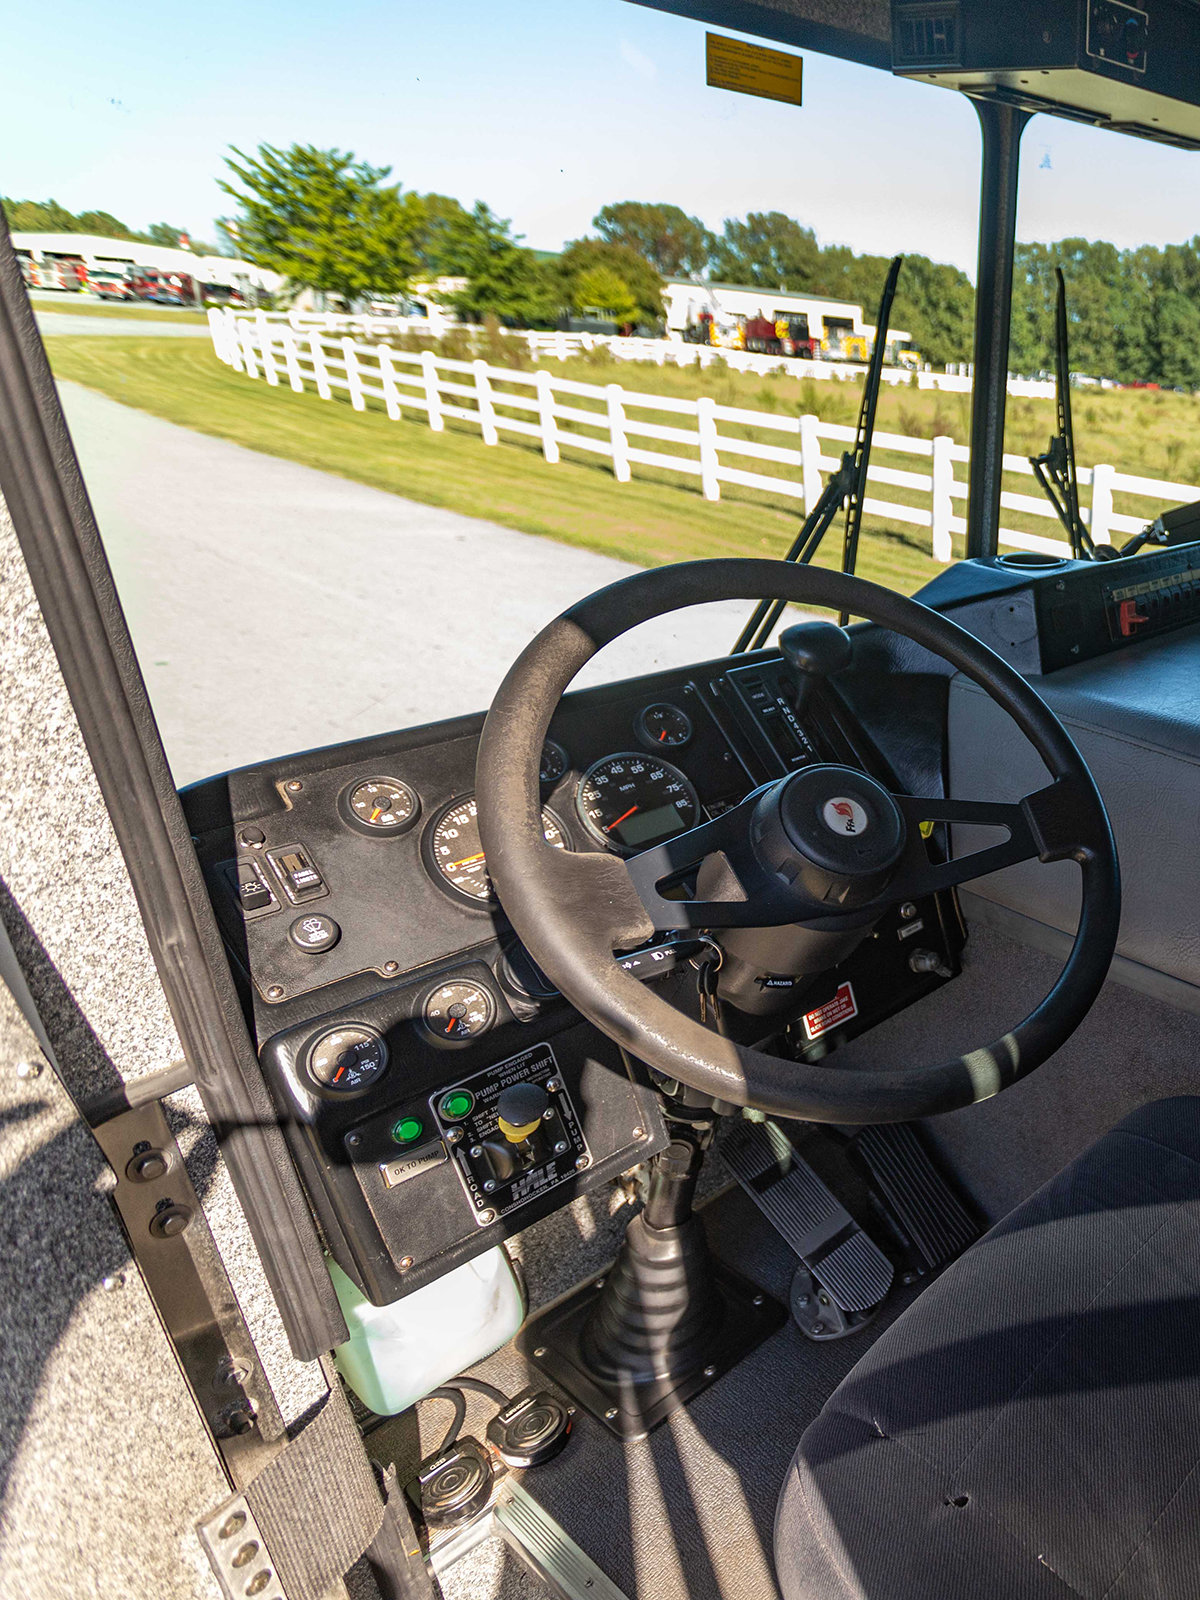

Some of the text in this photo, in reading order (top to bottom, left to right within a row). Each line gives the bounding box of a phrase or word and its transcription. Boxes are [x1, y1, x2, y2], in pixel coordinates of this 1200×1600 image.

[610, 765, 624, 774] 45
[630, 764, 645, 774] 55
[594, 775, 609, 785] 35
[619, 783, 636, 792] MPH
[666, 783, 680, 793] 75
[587, 790, 602, 801] 25
[588, 808, 603, 819] 15
[452, 814, 469, 825] 15
[442, 828, 458, 840] 10
[440, 846, 450, 856] 5
[354, 1042, 369, 1050] 115
[360, 1062, 375, 1071] 150
[487, 1052, 533, 1078] PUMP ENGAGED
[498, 1062, 526, 1078] WHEN LIT
[475, 1056, 553, 1100] PUMP POWER SHIFT
[472, 1111, 488, 1122] SHIFT
[476, 1122, 492, 1133] SHIFT
[568, 1121, 583, 1151] PUMP
[394, 1150, 439, 1176] OK TO PUMP
[510, 1161, 558, 1201] HALE
[466, 1177, 484, 1208] ROAD
[505, 1398, 530, 1418] AIRHORN
